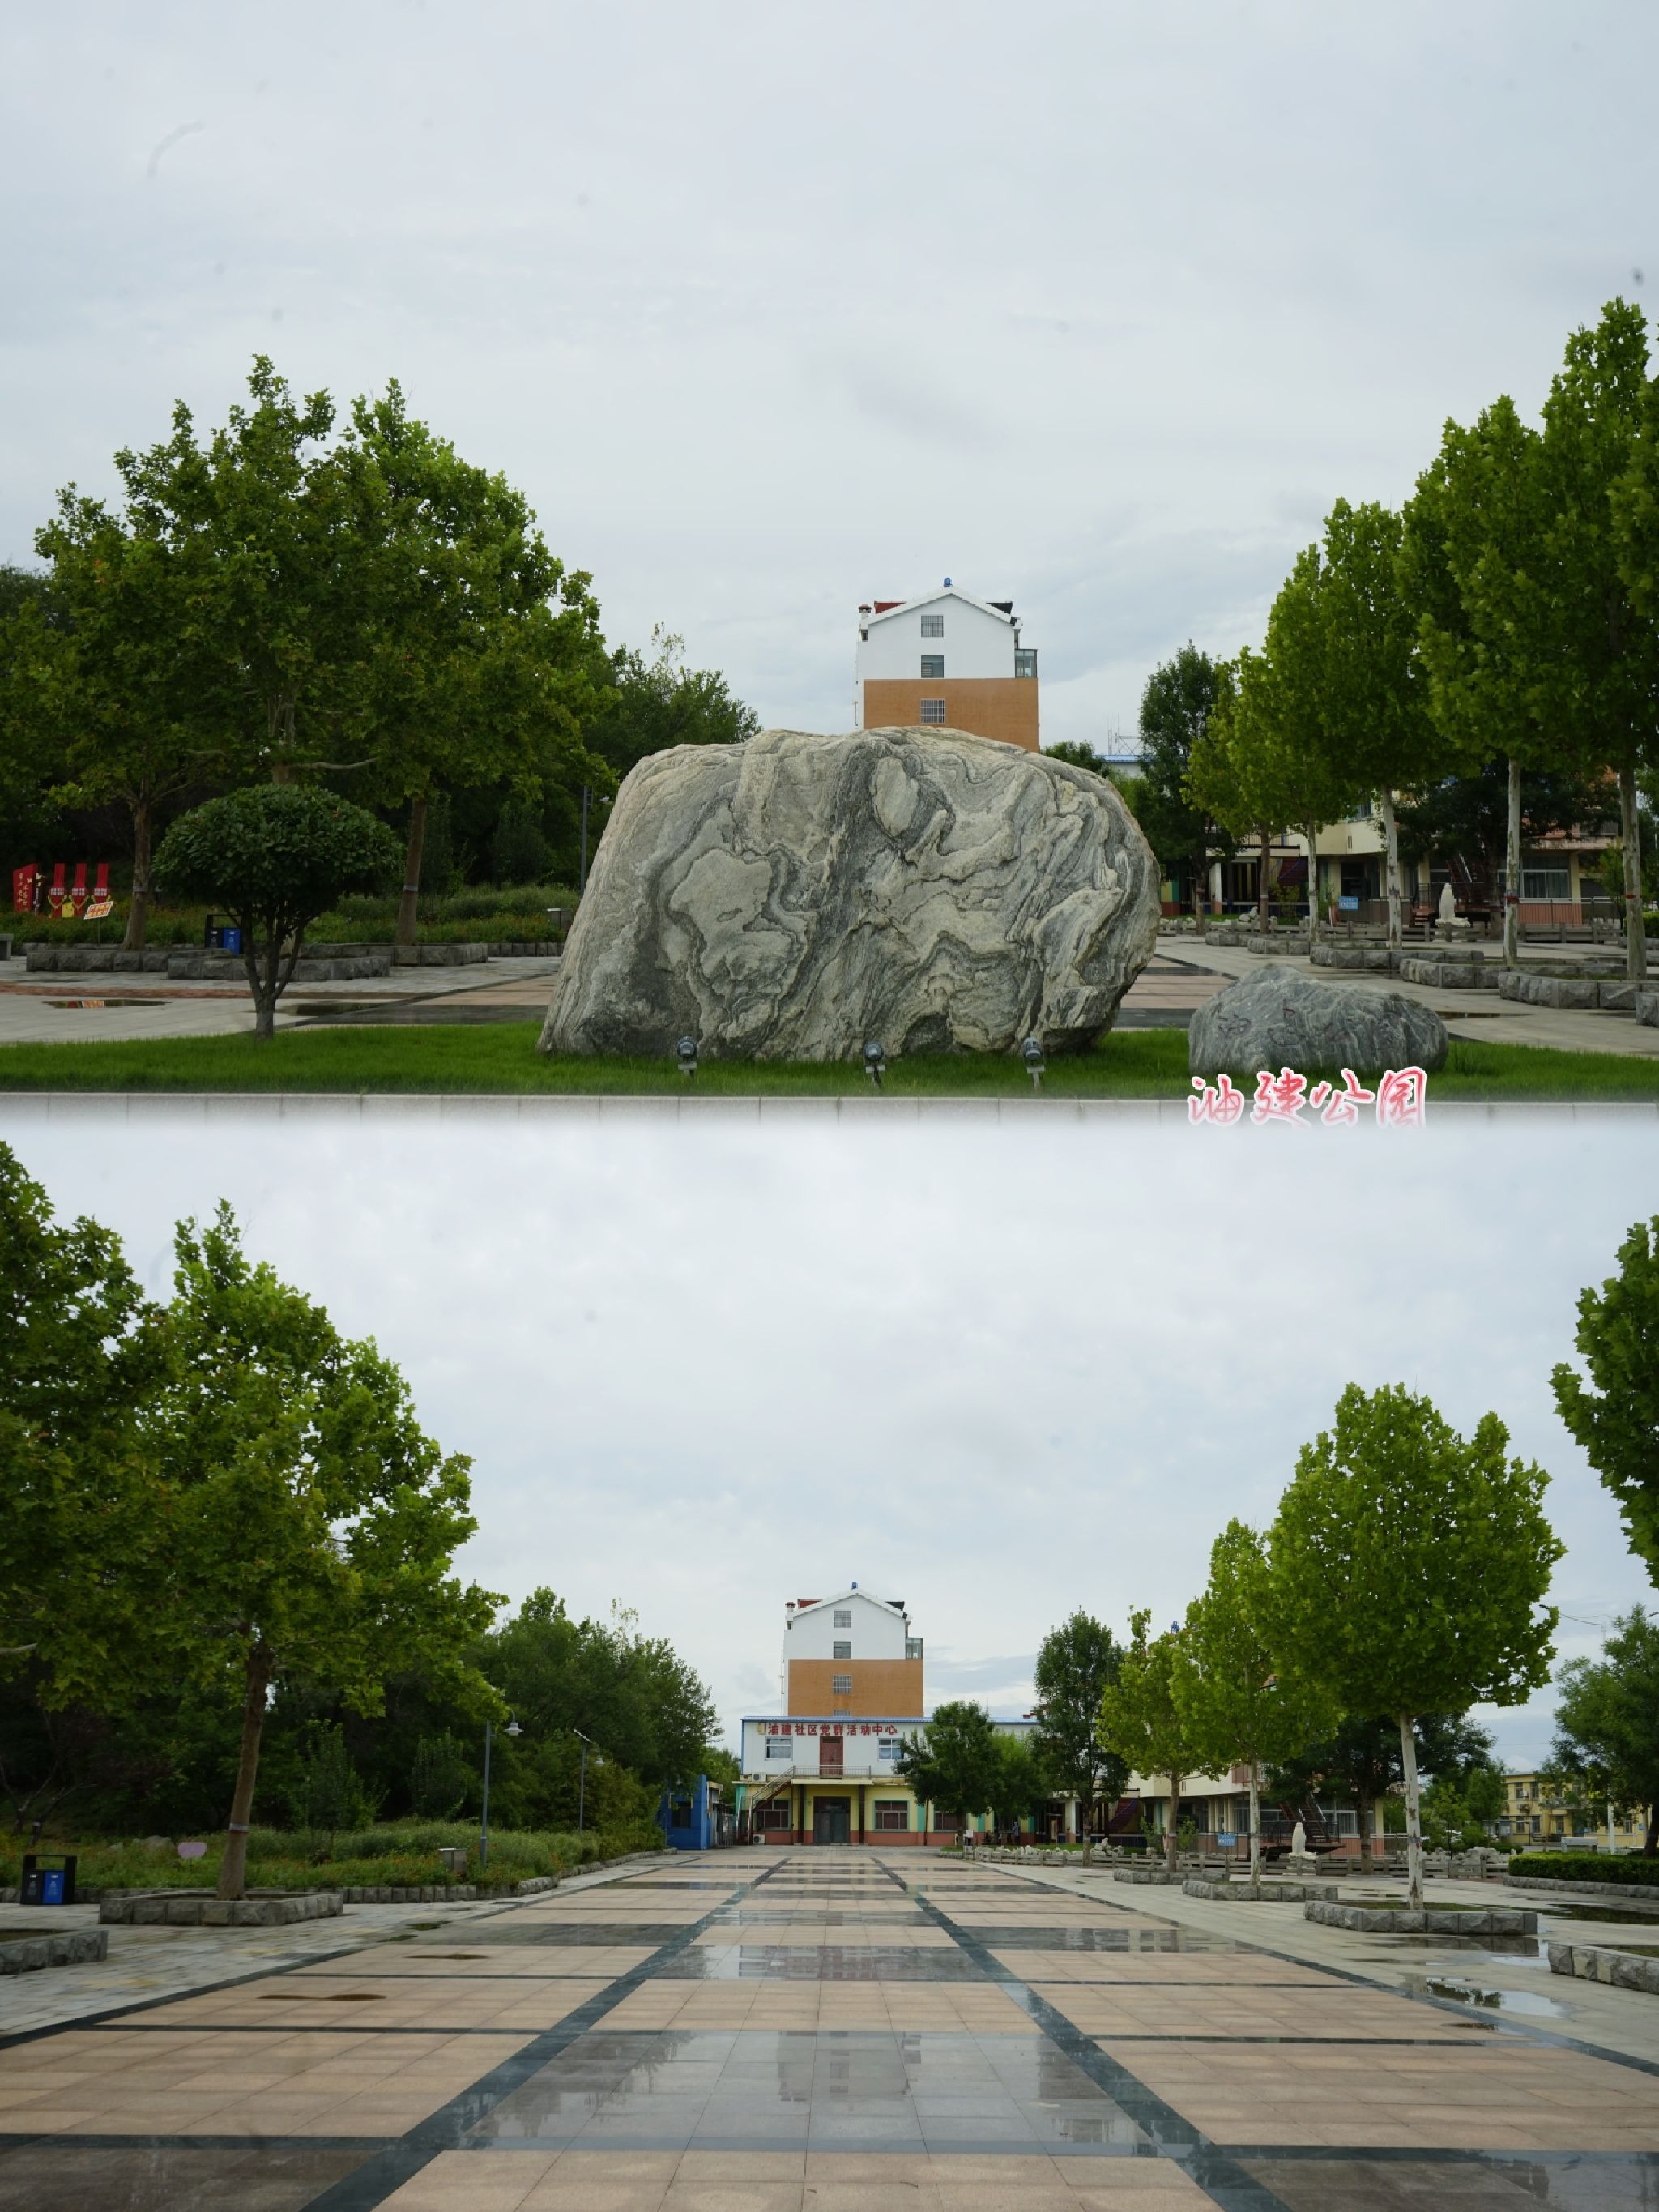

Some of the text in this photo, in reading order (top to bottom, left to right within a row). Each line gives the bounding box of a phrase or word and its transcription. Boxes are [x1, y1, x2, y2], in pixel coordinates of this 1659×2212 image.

[768, 1723, 898, 1736] 油建社区党群活动中心
